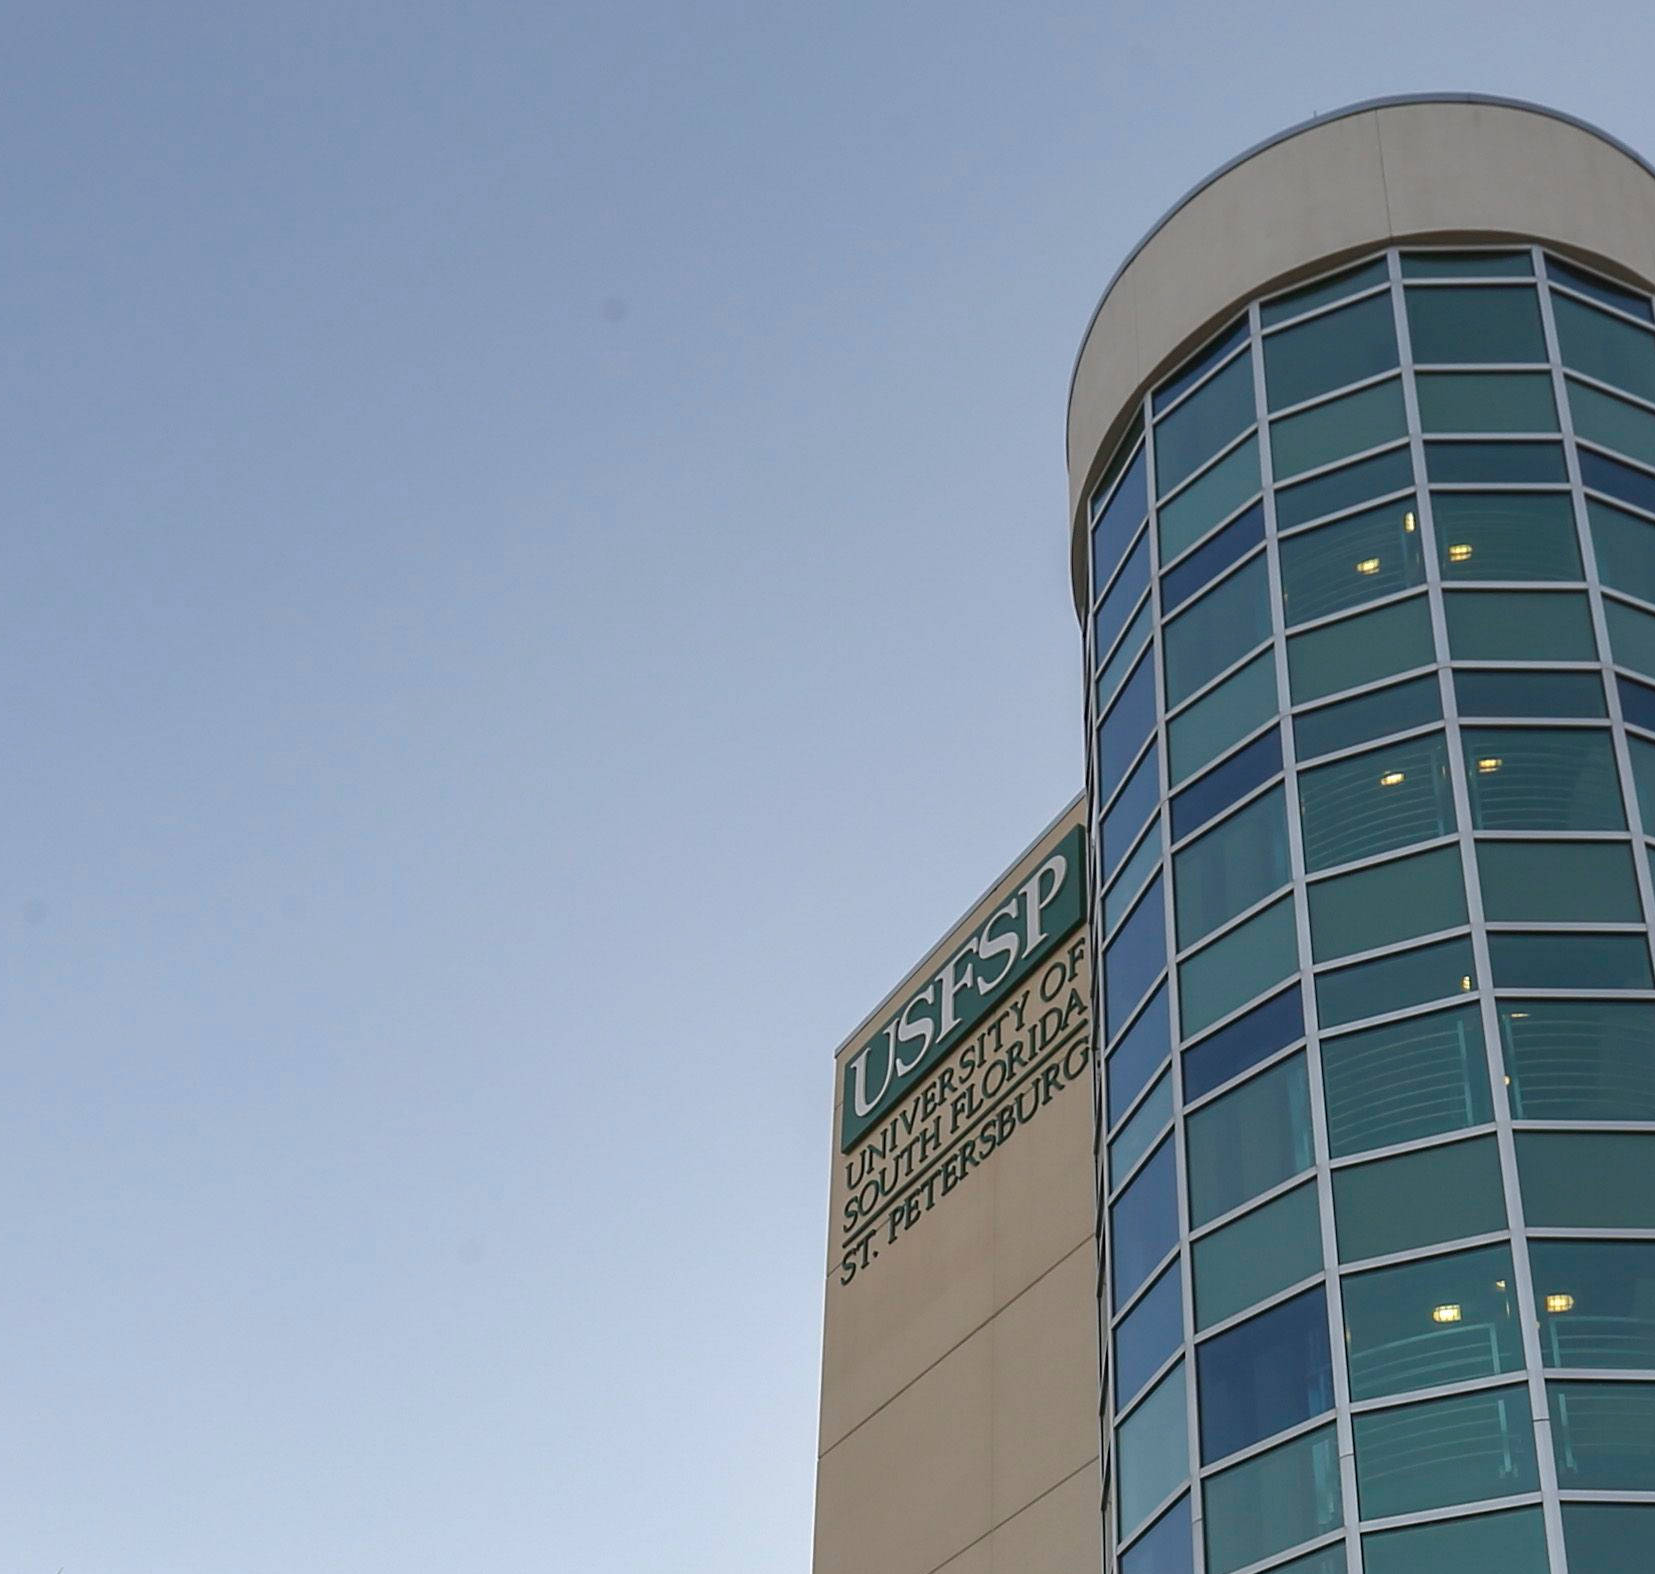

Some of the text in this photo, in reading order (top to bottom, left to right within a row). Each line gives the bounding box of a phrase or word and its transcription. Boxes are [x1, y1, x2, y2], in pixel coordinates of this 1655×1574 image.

[843, 987, 1089, 1235] SOUTH FLORIDA
[845, 937, 1087, 1189] UNIVERSITY OF
[850, 854, 1068, 1119] USFSP
[840, 1035, 1090, 1287] ST. PETERSBURG
